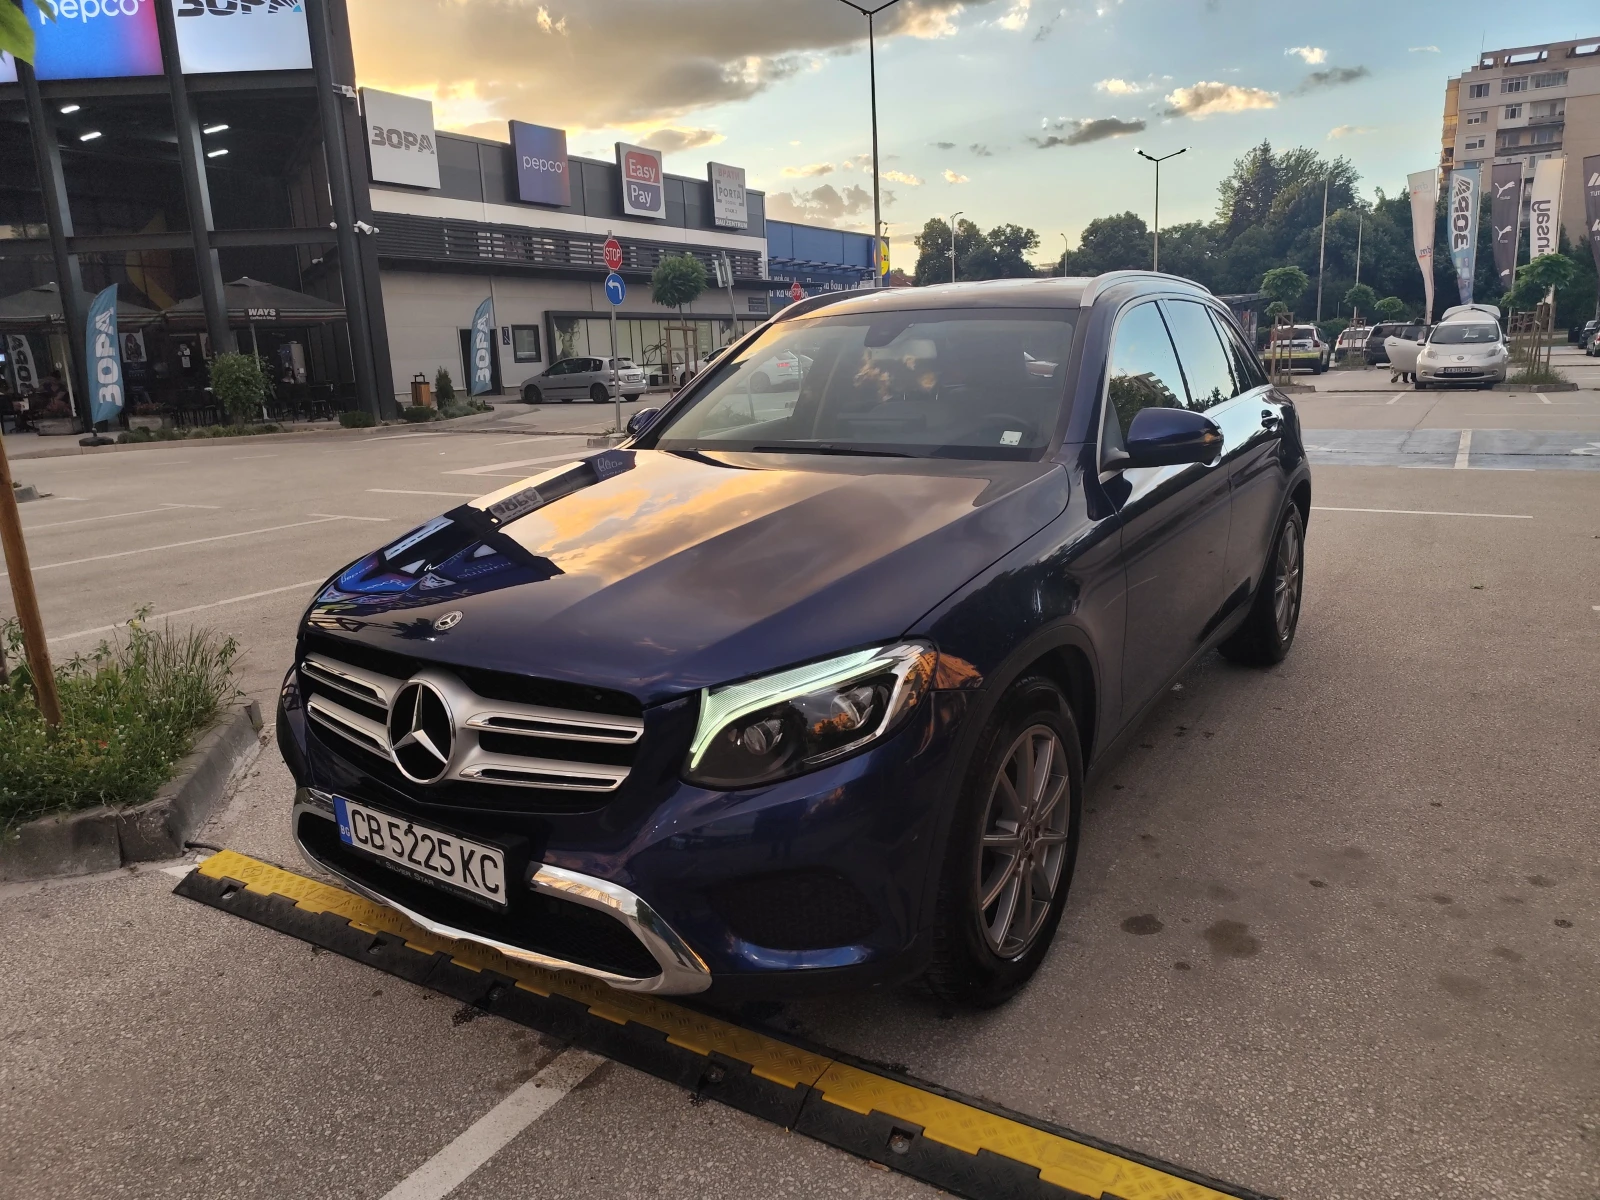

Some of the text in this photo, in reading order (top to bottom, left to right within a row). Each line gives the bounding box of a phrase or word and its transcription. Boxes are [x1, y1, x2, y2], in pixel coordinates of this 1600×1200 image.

[371, 125, 435, 155] ЗОРА
[522, 155, 563, 174] pepco
[628, 158, 656, 182] Easy
[630, 184, 652, 207] Pay
[718, 186, 742, 200] PORTA
[605, 247, 621, 262] STOP
[776, 287, 809, 298] качево
[248, 308, 276, 316] WAYS
[95, 306, 123, 406] ЗОРА
[475, 313, 491, 384] ЗОРА
[340, 824, 351, 836] BG
[351, 809, 500, 894] CB 5225 KC
